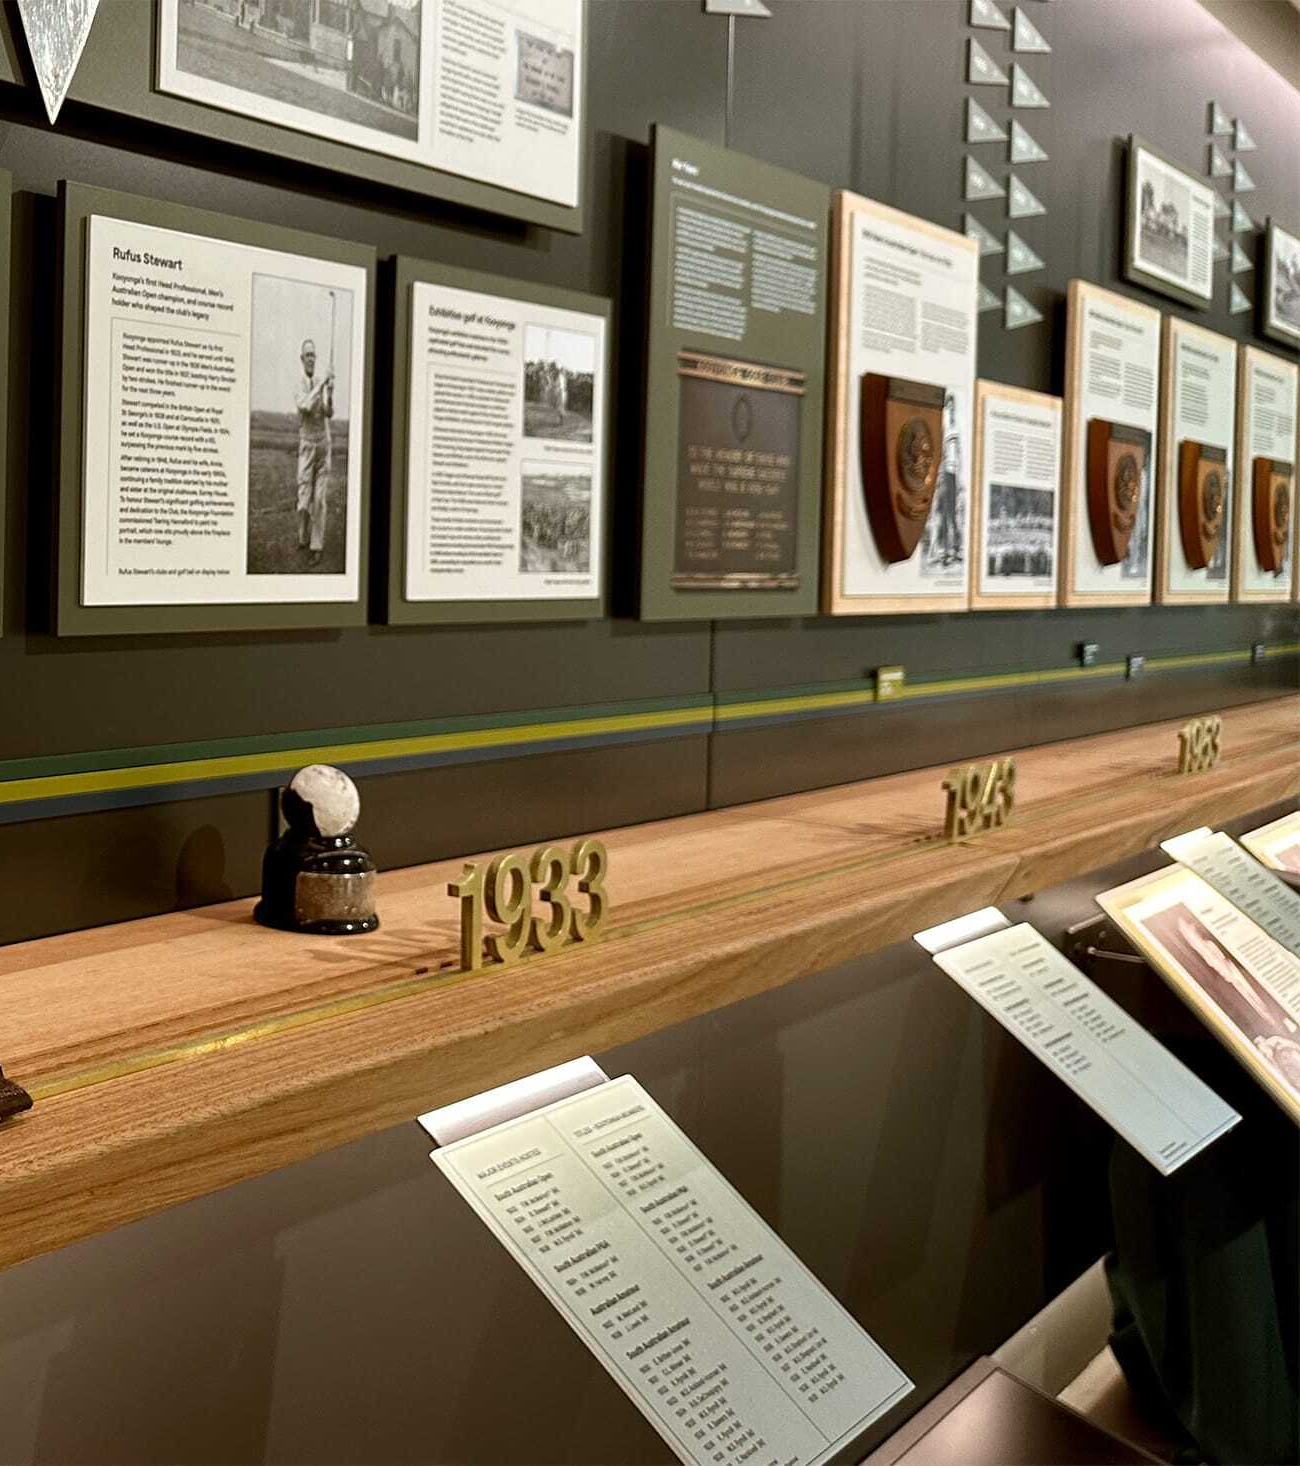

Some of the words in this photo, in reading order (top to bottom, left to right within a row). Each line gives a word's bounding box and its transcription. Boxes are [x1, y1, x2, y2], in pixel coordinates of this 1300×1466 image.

[112, 246, 142, 263] Rufus
[143, 252, 182, 271] Stewart
[941, 756, 1016, 841] 1943
[447, 839, 609, 971] 1933
